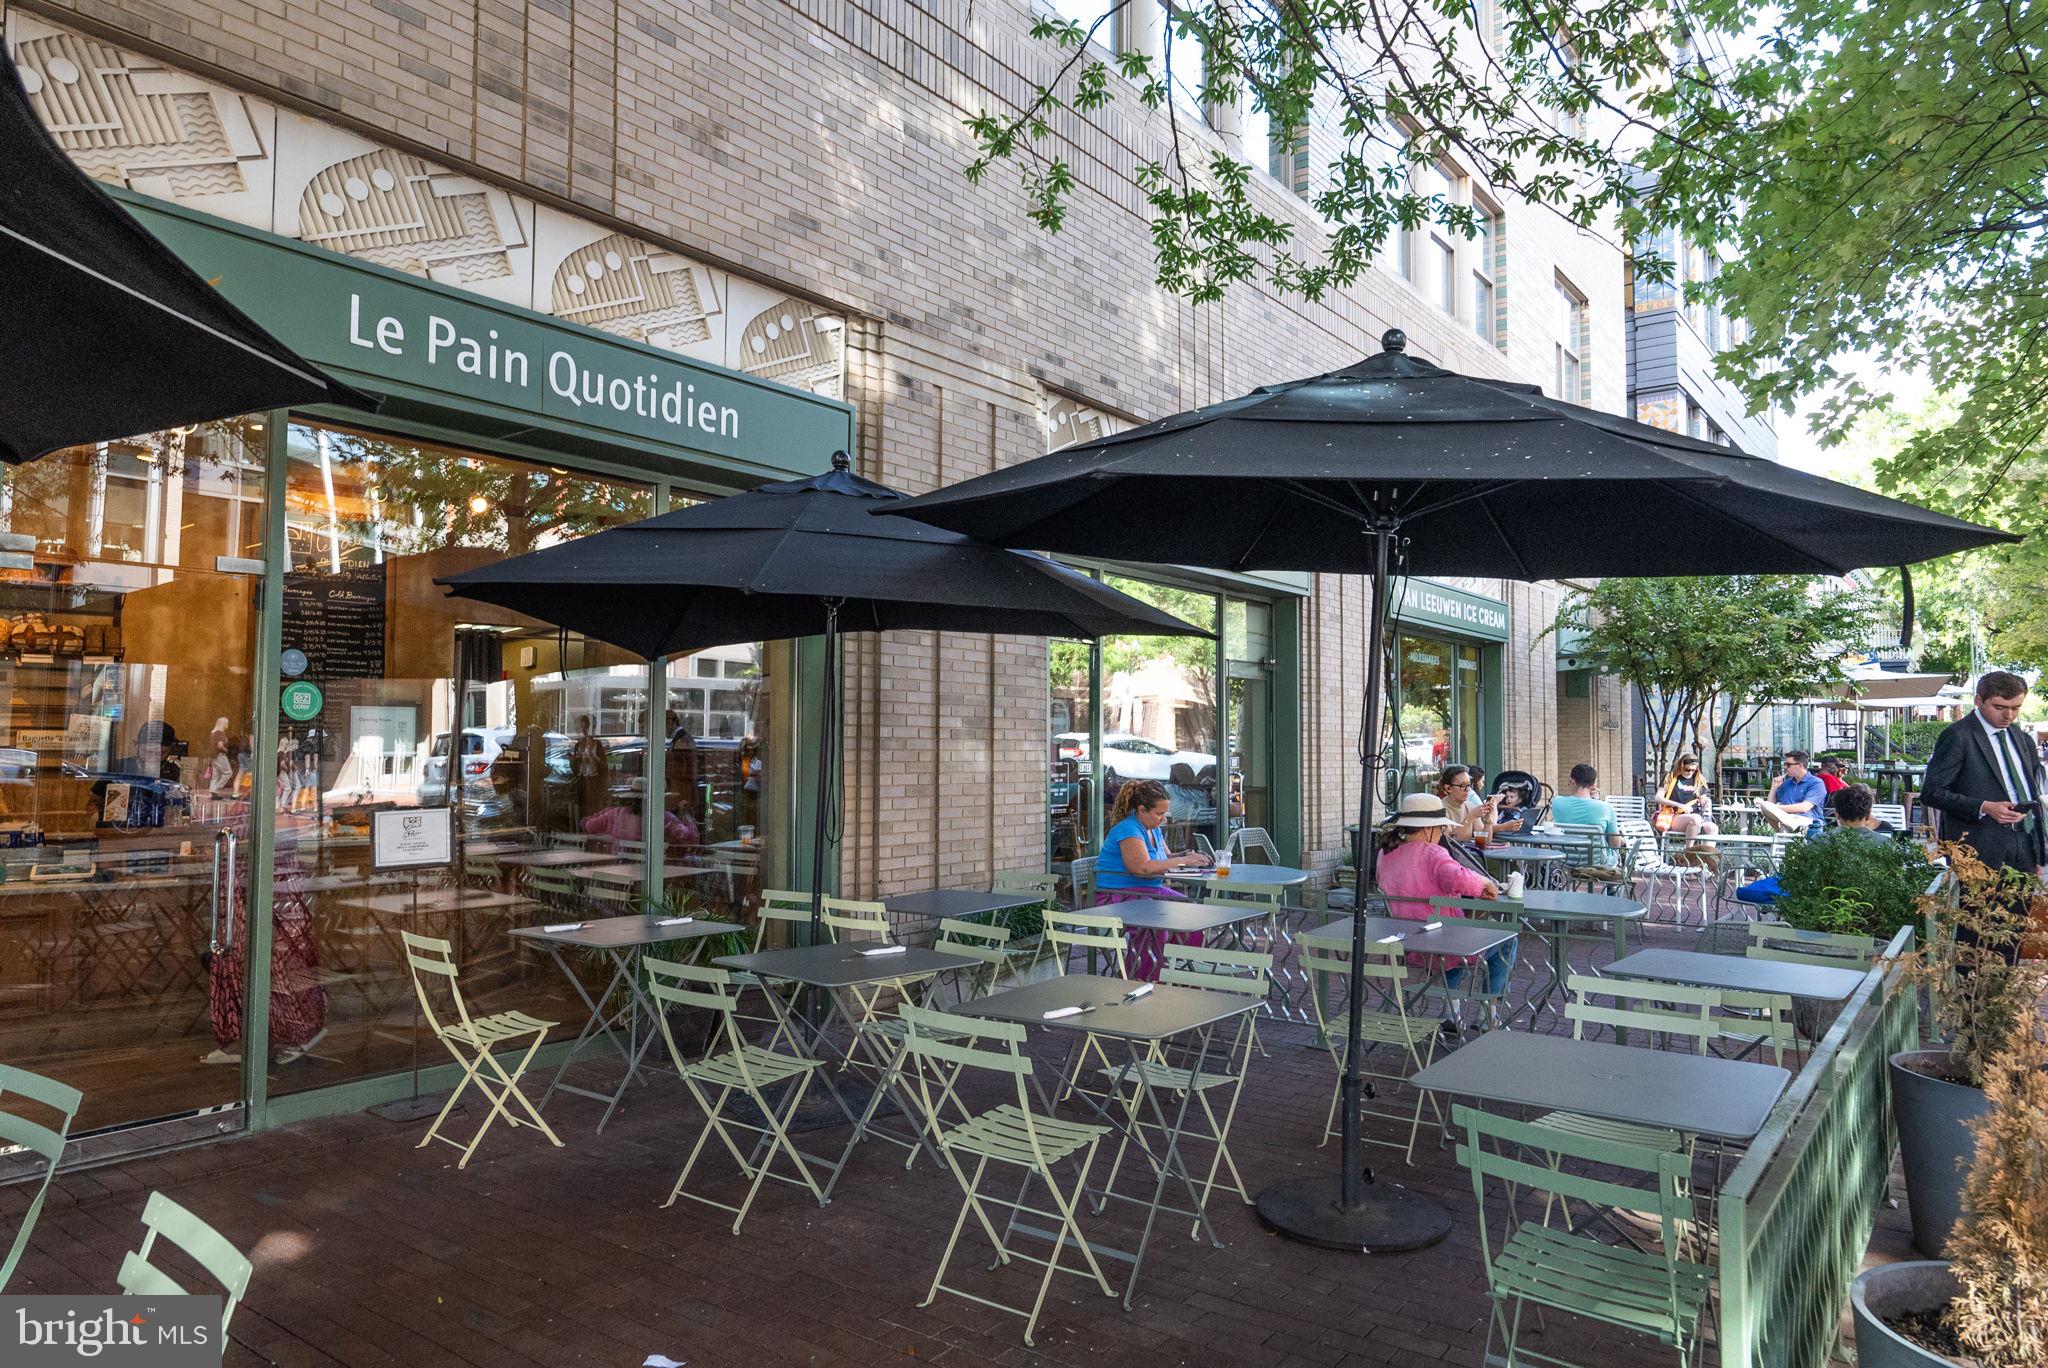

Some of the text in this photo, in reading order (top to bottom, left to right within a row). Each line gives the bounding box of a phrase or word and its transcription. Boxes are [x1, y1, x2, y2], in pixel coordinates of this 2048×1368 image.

[349, 293, 739, 439] Le Pain Quotidien
[328, 589, 376, 603] Cold Beverages
[1420, 591, 1462, 619] LEEUWEN
[1463, 603, 1478, 623] ICE
[1478, 607, 1506, 630] CREAM
[22, 735, 54, 743] Baguette
